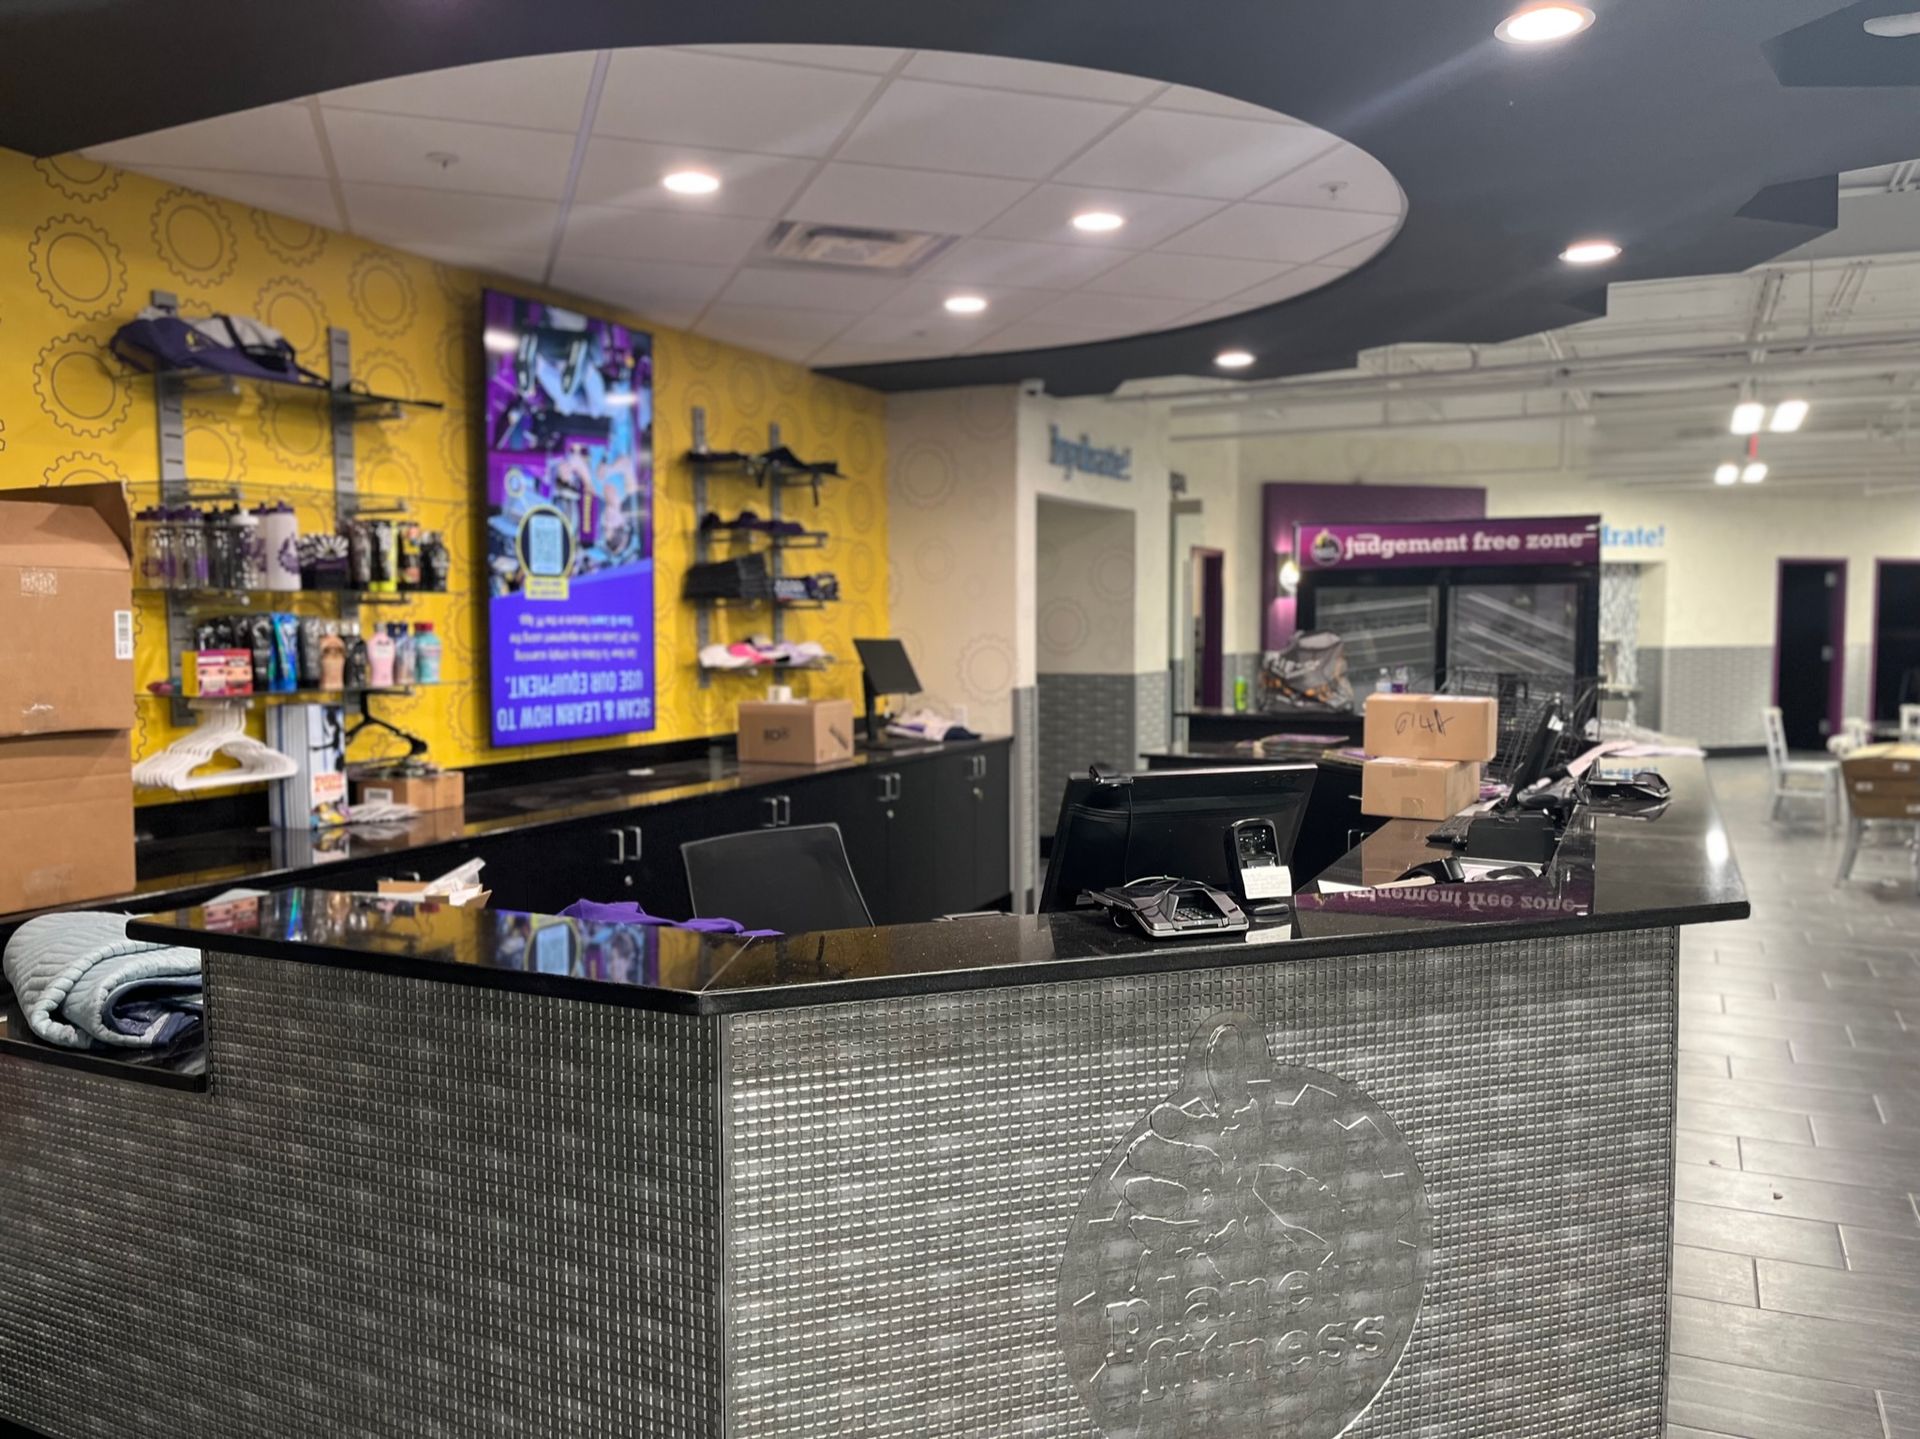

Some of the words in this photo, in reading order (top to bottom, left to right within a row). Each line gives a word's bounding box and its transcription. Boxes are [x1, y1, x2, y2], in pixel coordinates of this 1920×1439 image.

[1344, 532, 1465, 559] judgement
[1472, 531, 1520, 551] free
[1525, 531, 1584, 549] zone
[504, 670, 588, 700] EQUIPMENT.
[589, 670, 617, 693] OUR
[618, 669, 644, 692] USE
[496, 706, 517, 732] TO
[519, 704, 553, 730] HOW
[555, 700, 600, 726] LEARN
[602, 699, 615, 722] &
[616, 697, 651, 721] SCAN
